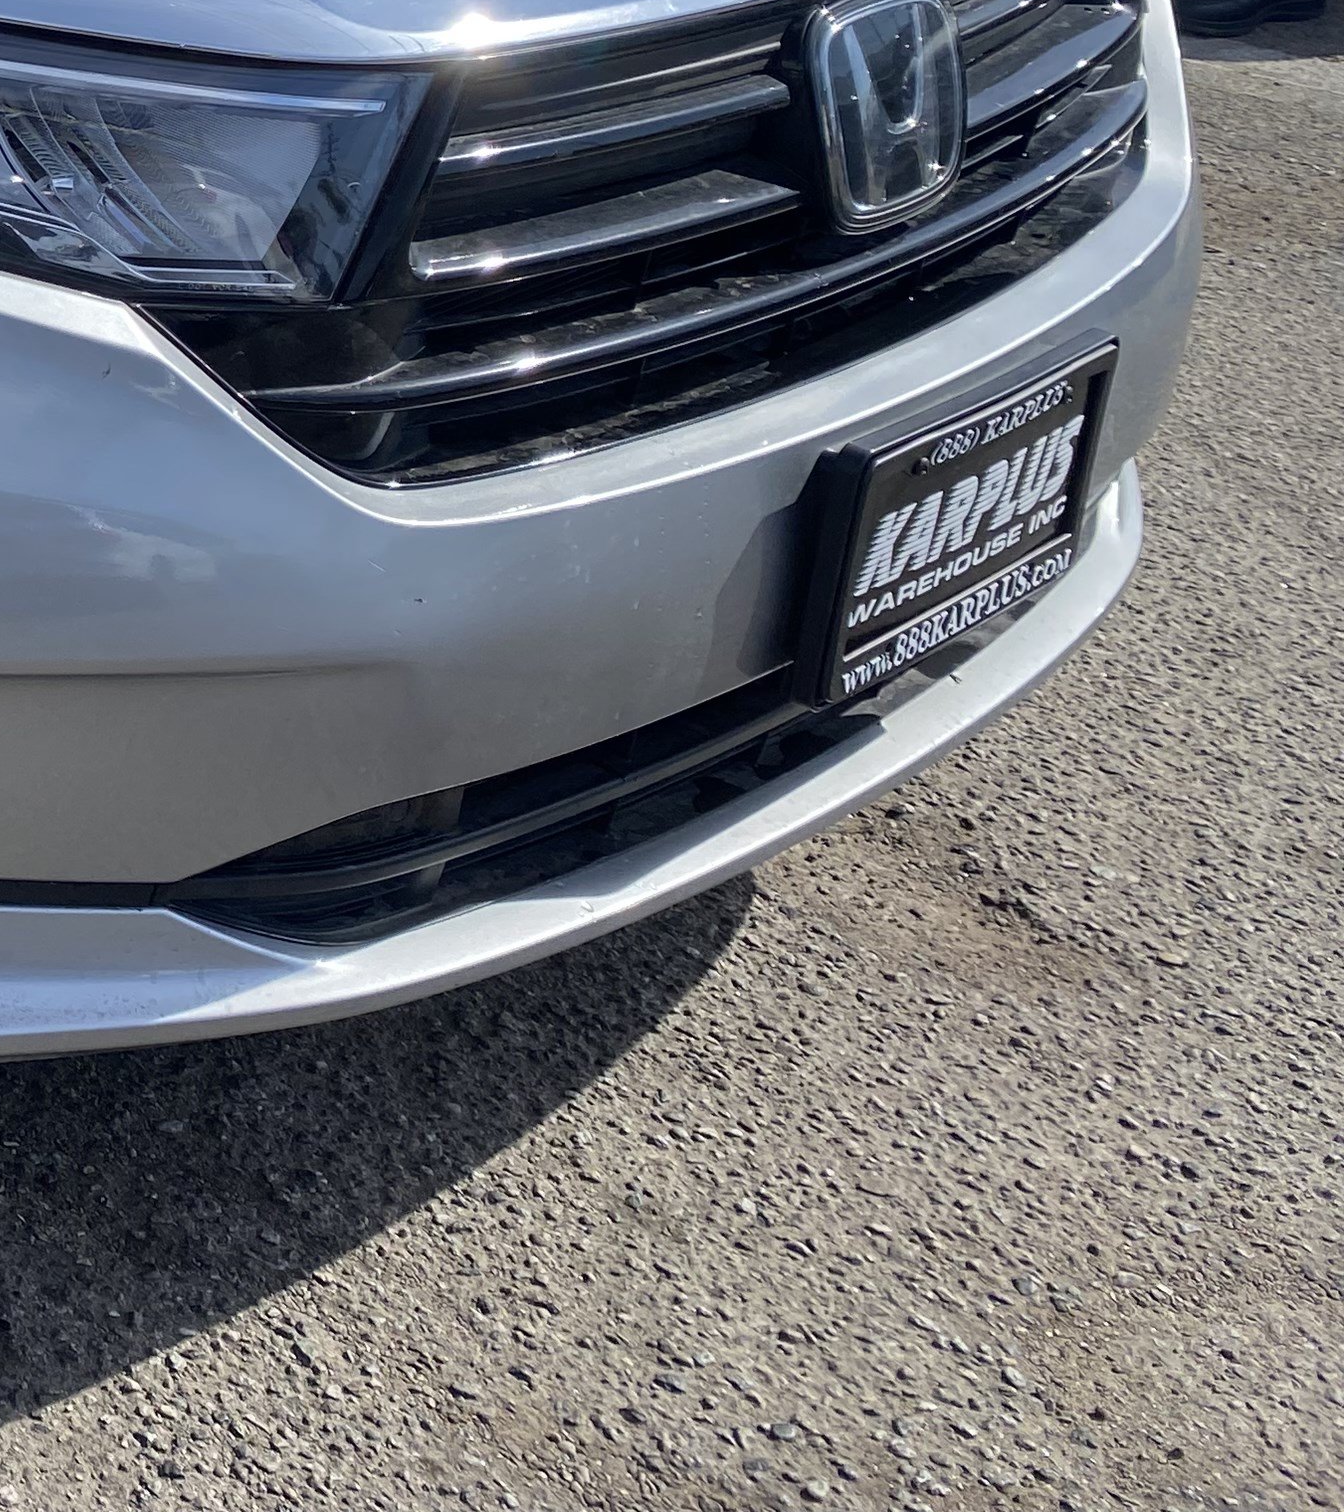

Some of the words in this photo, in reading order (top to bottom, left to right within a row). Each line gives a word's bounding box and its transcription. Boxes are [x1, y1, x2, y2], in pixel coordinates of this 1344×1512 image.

[930, 427, 981, 466] (888)
[981, 381, 1069, 445] KARPLUS
[853, 414, 1084, 597] KARPLUS
[847, 523, 1023, 628] WAREHOUSE
